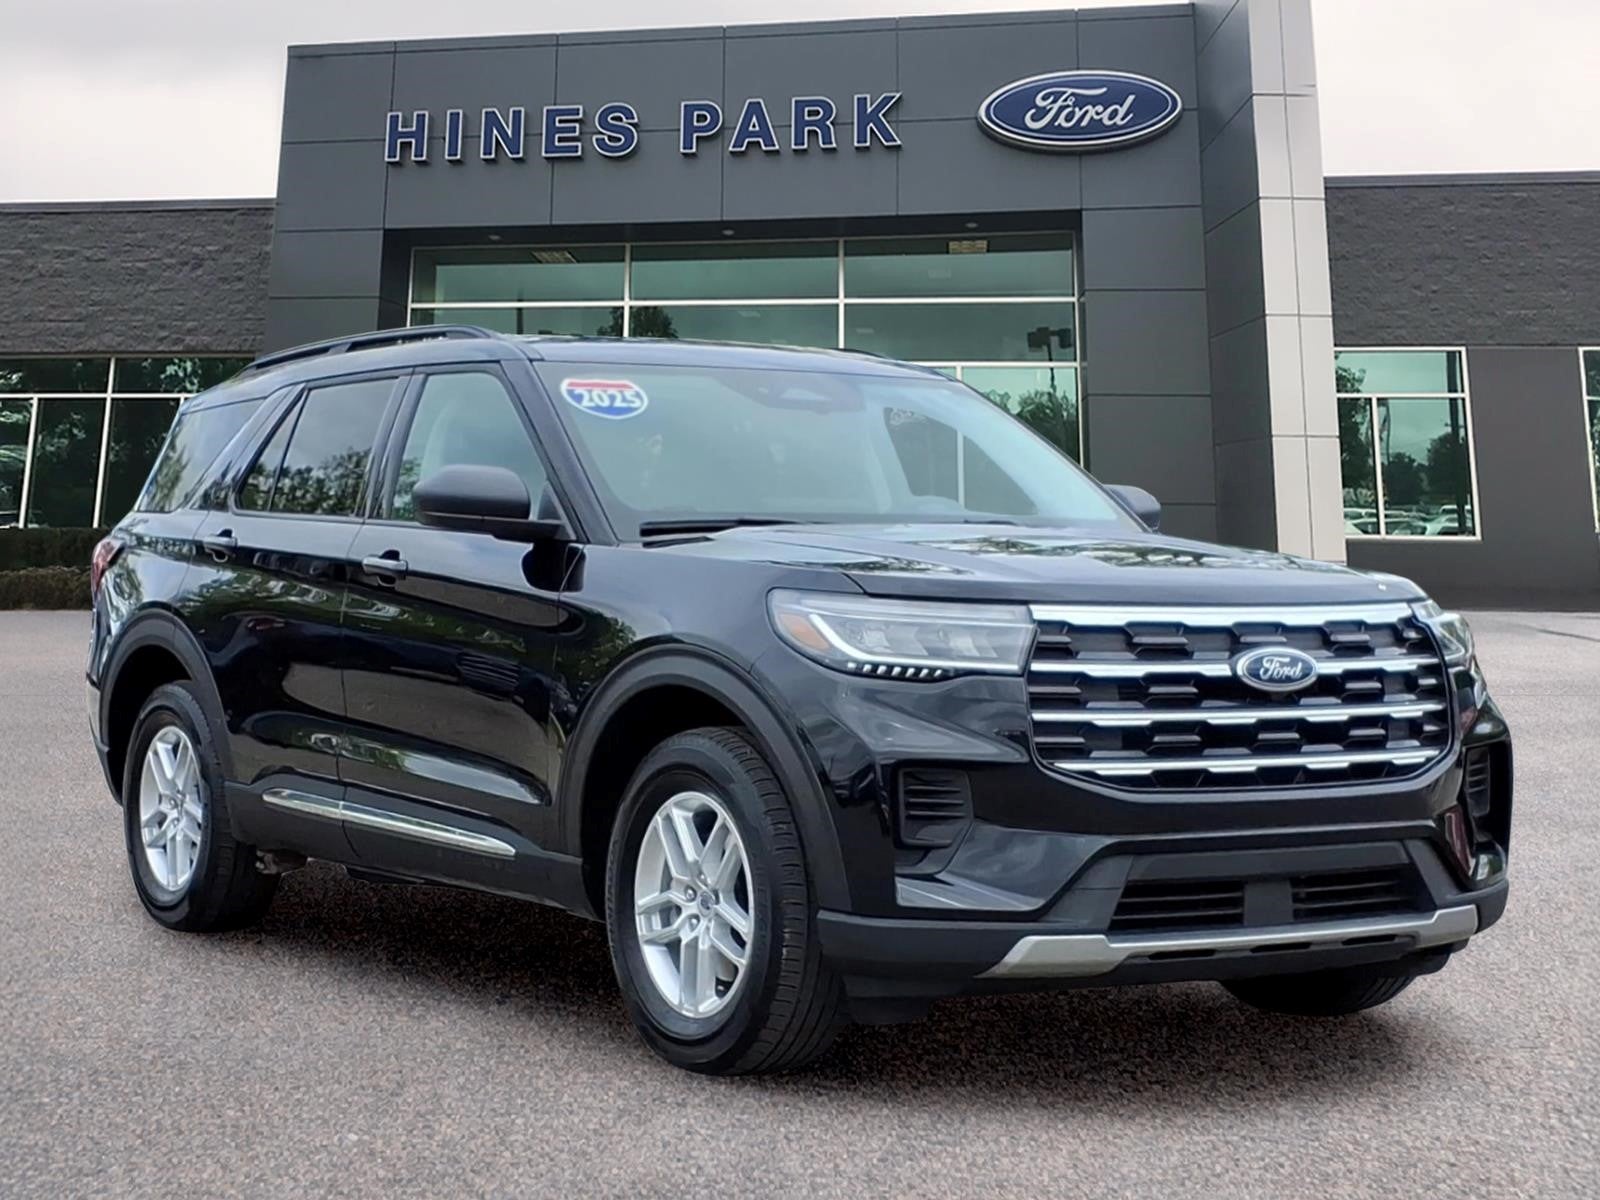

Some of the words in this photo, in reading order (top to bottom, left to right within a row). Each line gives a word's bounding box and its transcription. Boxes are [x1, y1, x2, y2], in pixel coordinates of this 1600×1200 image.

[1024, 87, 1136, 130] Ford
[384, 103, 638, 162] HINES
[679, 92, 903, 156] PARK
[574, 389, 642, 408] 2025
[1260, 656, 1303, 680] Ford
